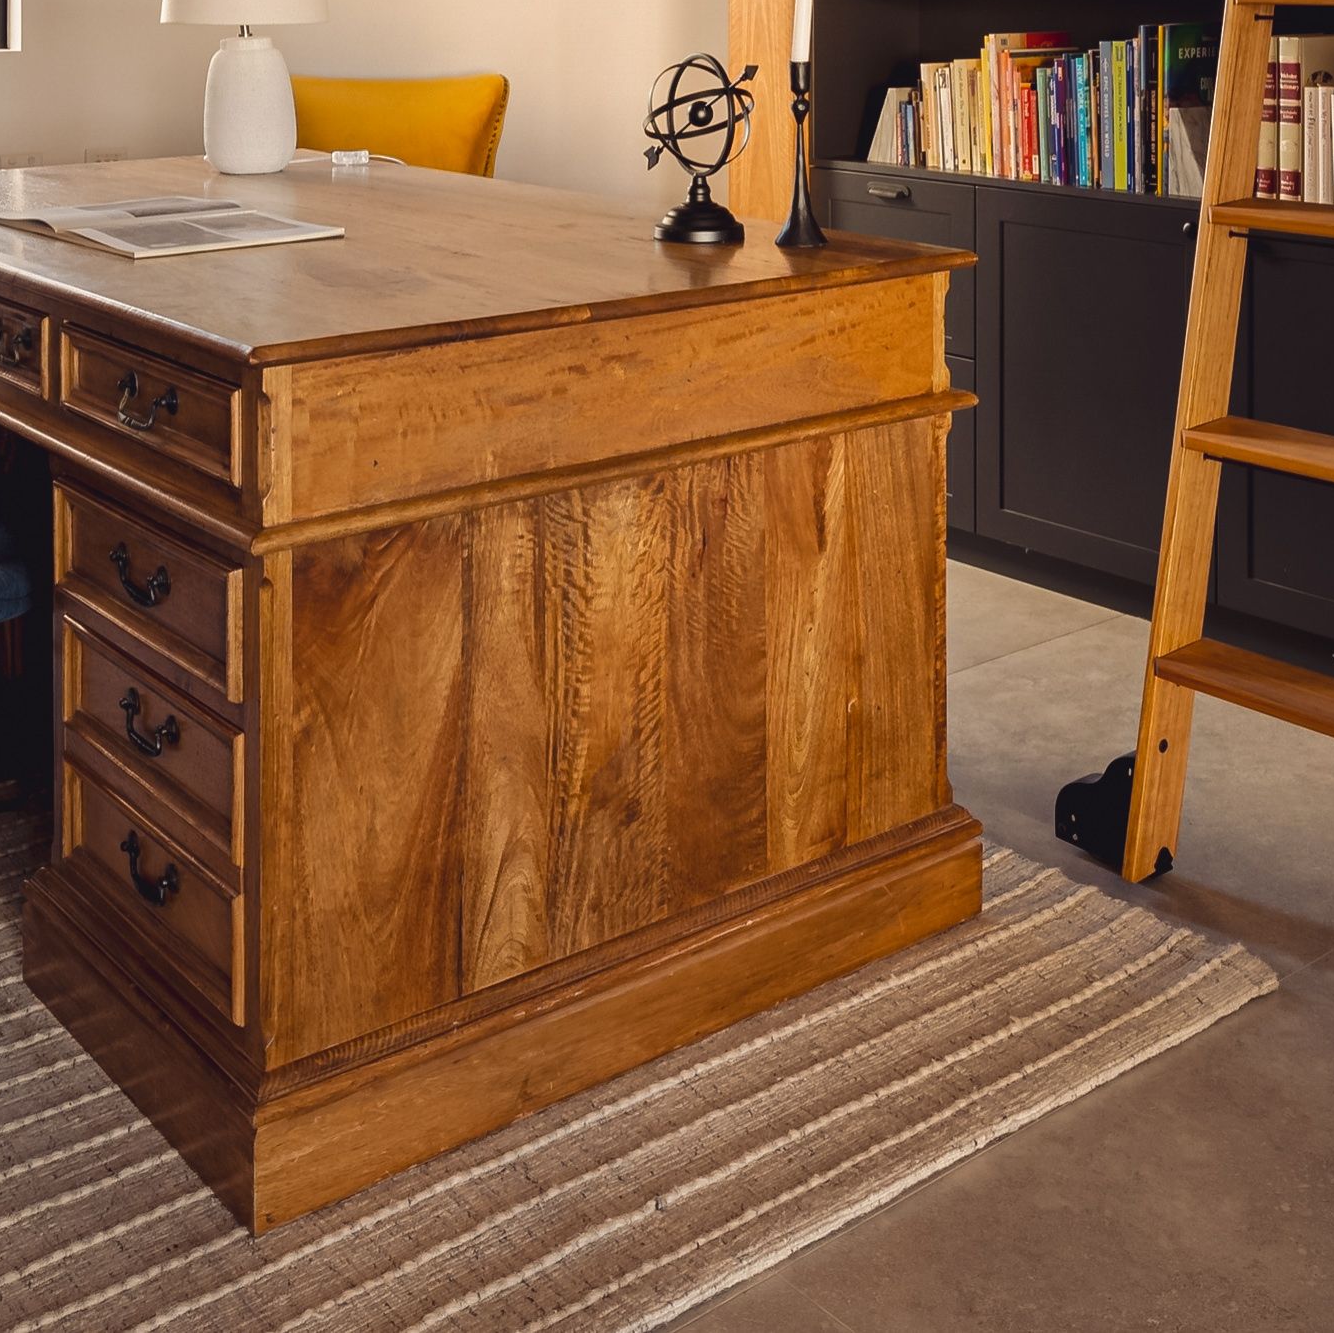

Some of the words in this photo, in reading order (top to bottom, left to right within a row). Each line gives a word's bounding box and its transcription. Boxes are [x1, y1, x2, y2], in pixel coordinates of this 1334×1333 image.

[1076, 64, 1084, 86] NEW
[1077, 87, 1085, 110] YORK
[1103, 133, 1111, 158] WORLD
